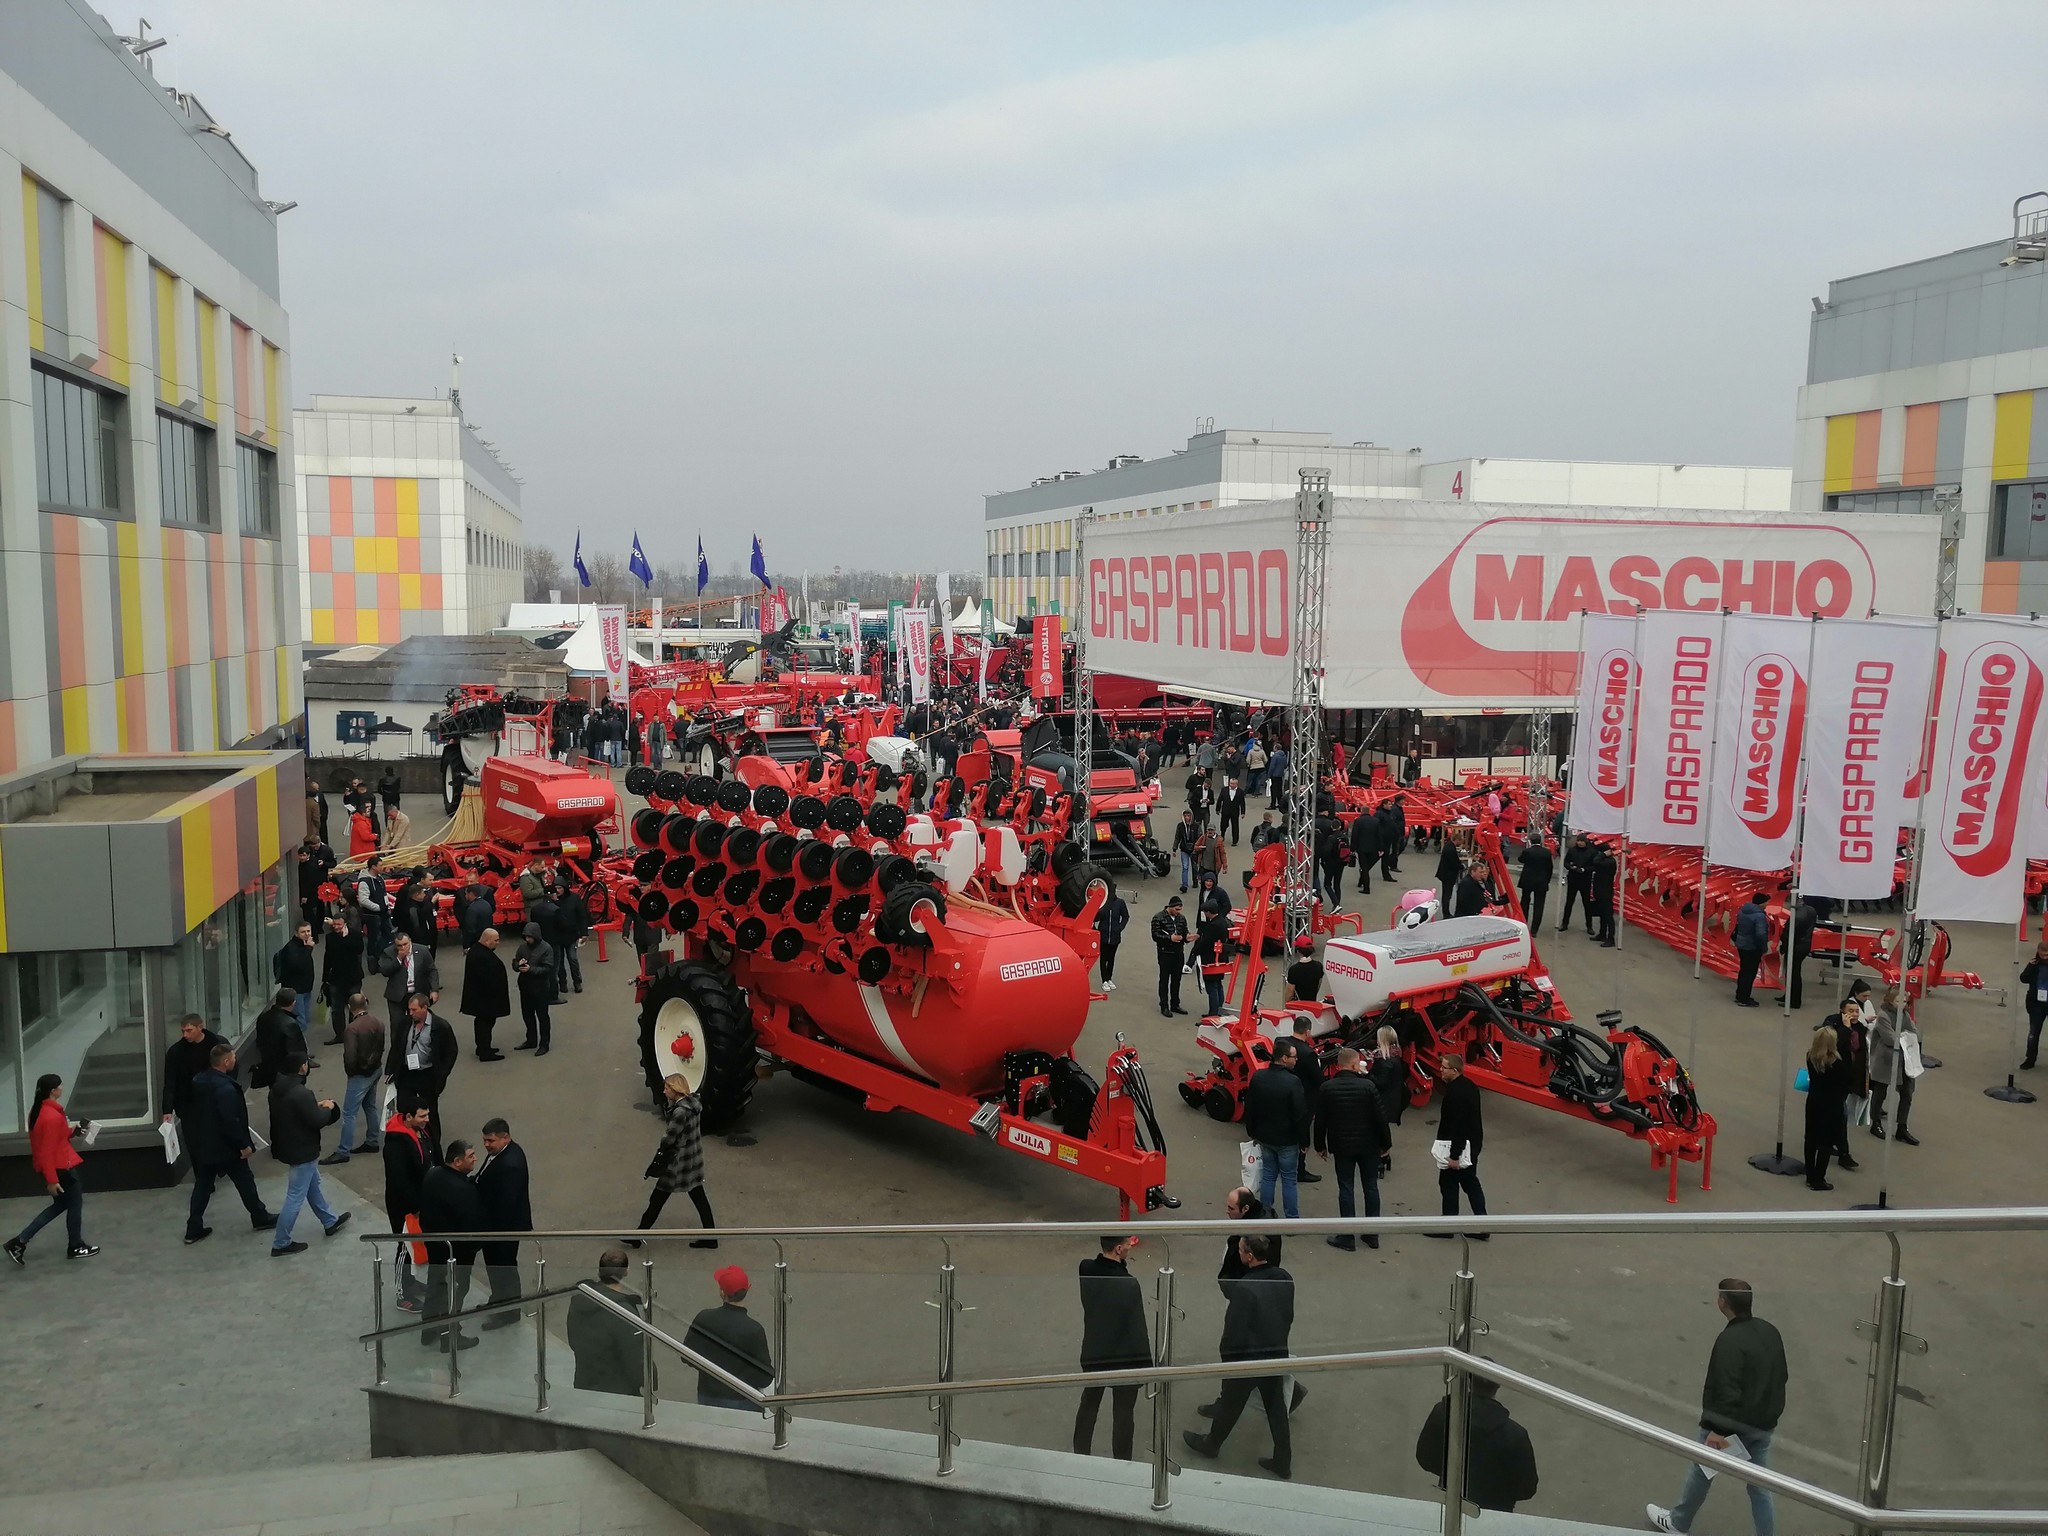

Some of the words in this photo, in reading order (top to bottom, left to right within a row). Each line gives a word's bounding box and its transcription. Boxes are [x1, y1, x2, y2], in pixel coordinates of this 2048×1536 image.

[1451, 470, 1463, 499] 4
[1090, 549, 1289, 657] GASPARDO
[1473, 554, 1853, 622] MASCHIO
[1598, 657, 1629, 788] MASCHIO
[1662, 636, 1713, 826] GASPARDO
[1742, 663, 1784, 815] MASCHIO
[1838, 660, 1894, 864] GASPARDO
[1952, 653, 2016, 846] MASCHIO
[558, 797, 604, 809] GASPARDO
[1001, 957, 1061, 980] GASPARDO
[1325, 959, 1373, 983] GASPARDO
[1446, 949, 1474, 962] GASPARDO
[1502, 951, 1522, 961] CHRONO
[1014, 1132, 1045, 1151] JULIA
